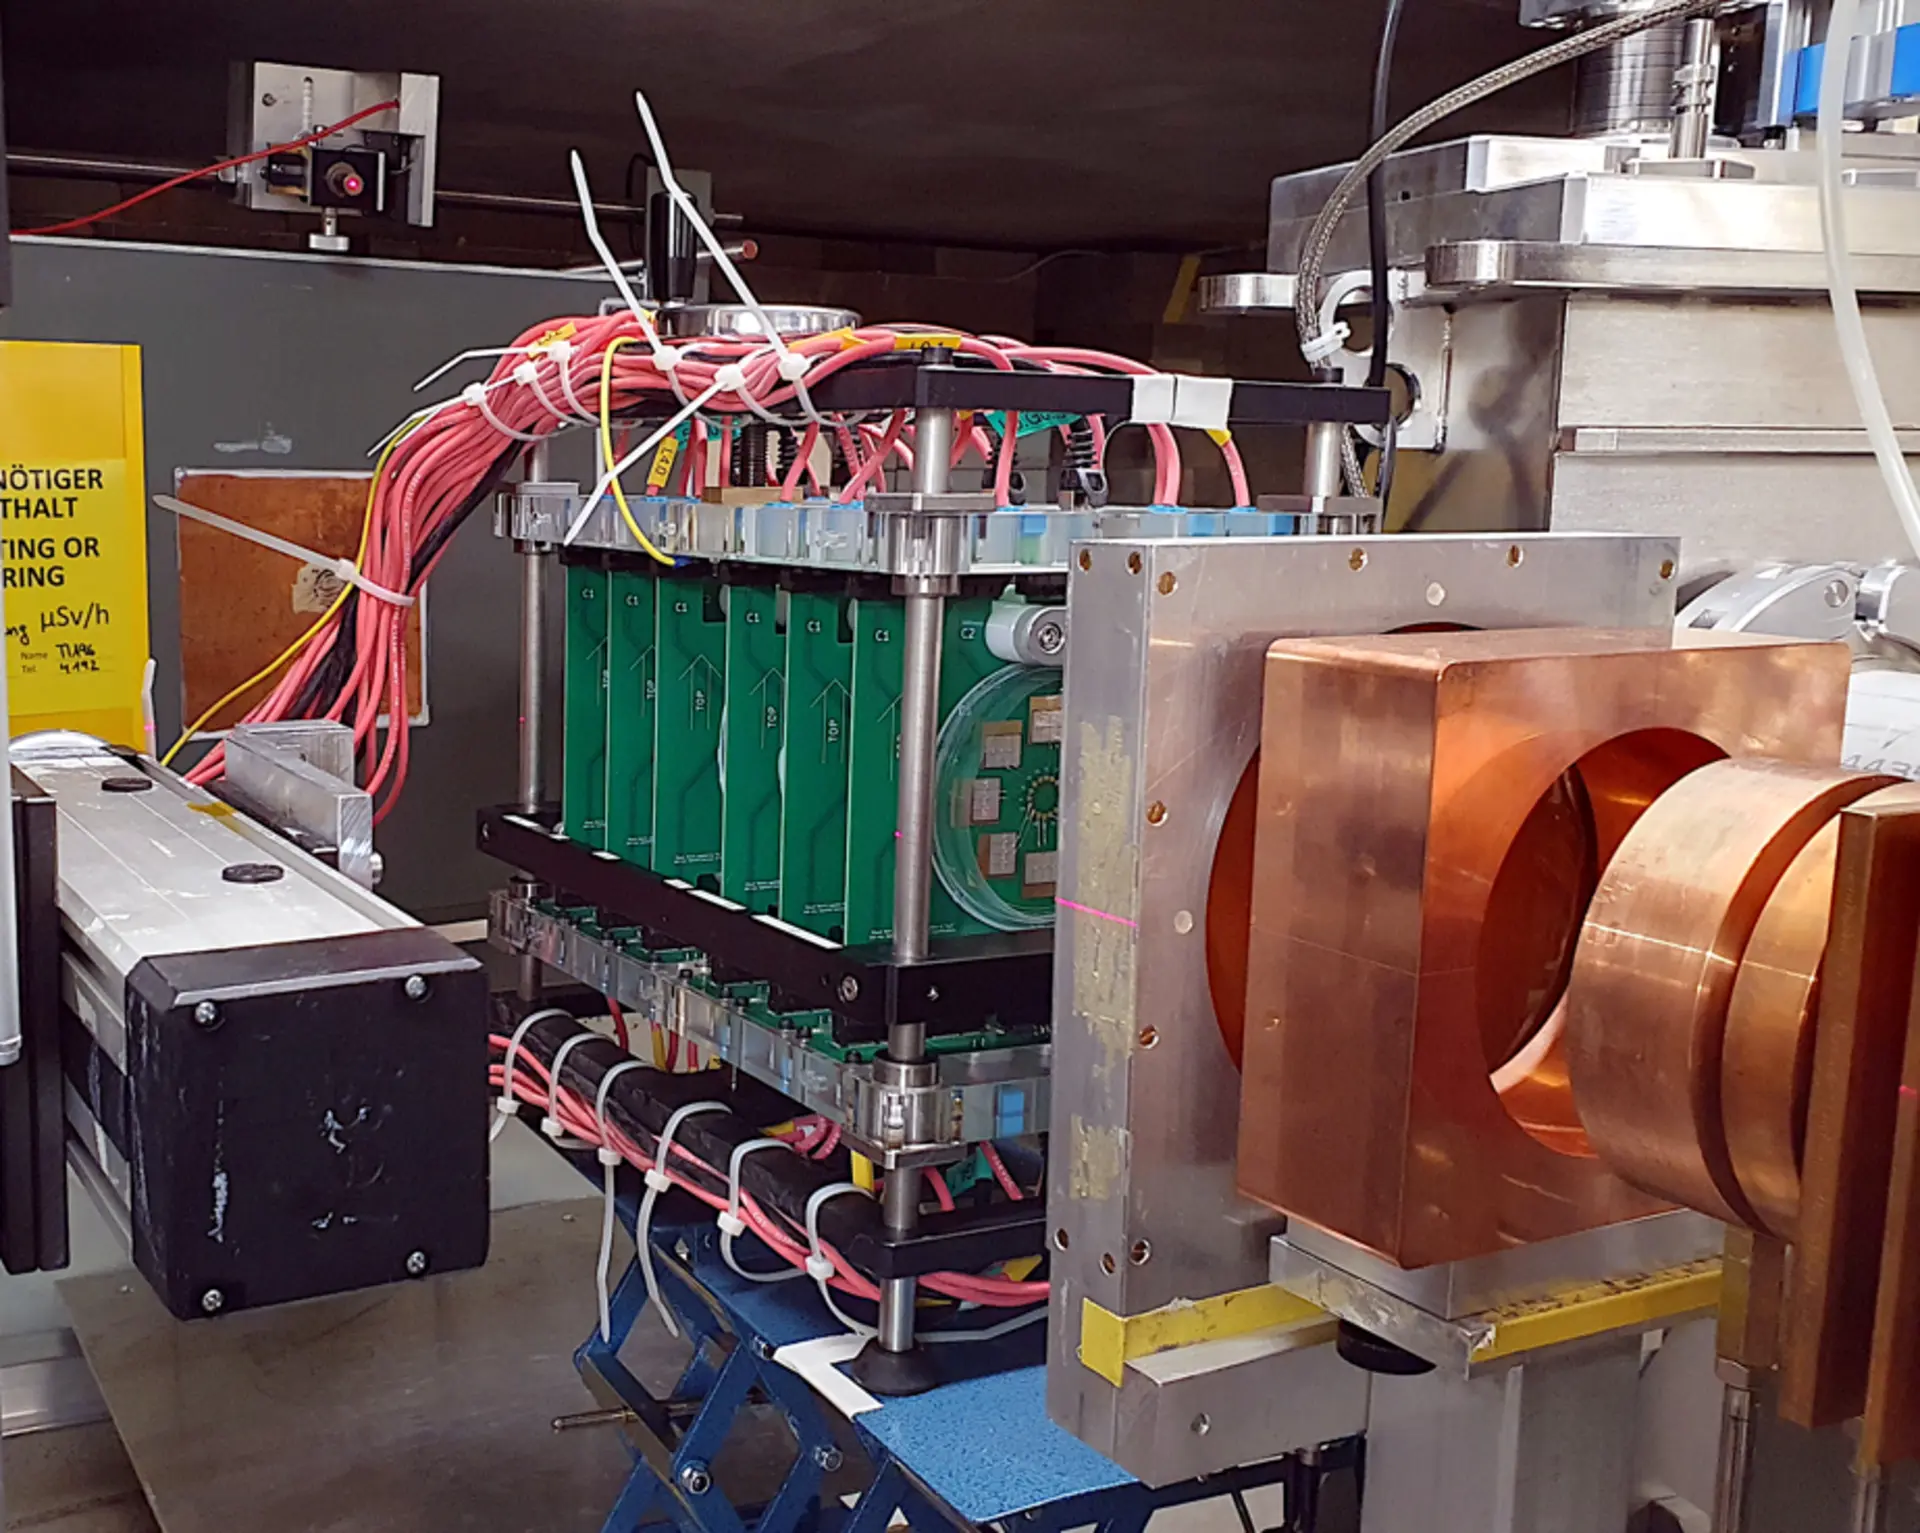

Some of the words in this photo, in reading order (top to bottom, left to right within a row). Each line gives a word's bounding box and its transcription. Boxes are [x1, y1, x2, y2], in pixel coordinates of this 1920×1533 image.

[0, 497, 78, 519] THALT
[63, 537, 100, 558] OR
[2, 565, 65, 588] RING
[582, 588, 594, 599] C1
[626, 595, 639, 606] C1
[675, 602, 687, 613] C1
[746, 613, 760, 623] C1
[807, 621, 821, 632] C1
[875, 630, 890, 642] C1
[960, 627, 976, 640] C2
[695, 690, 705, 712] TOP
[828, 719, 840, 743] TOP
